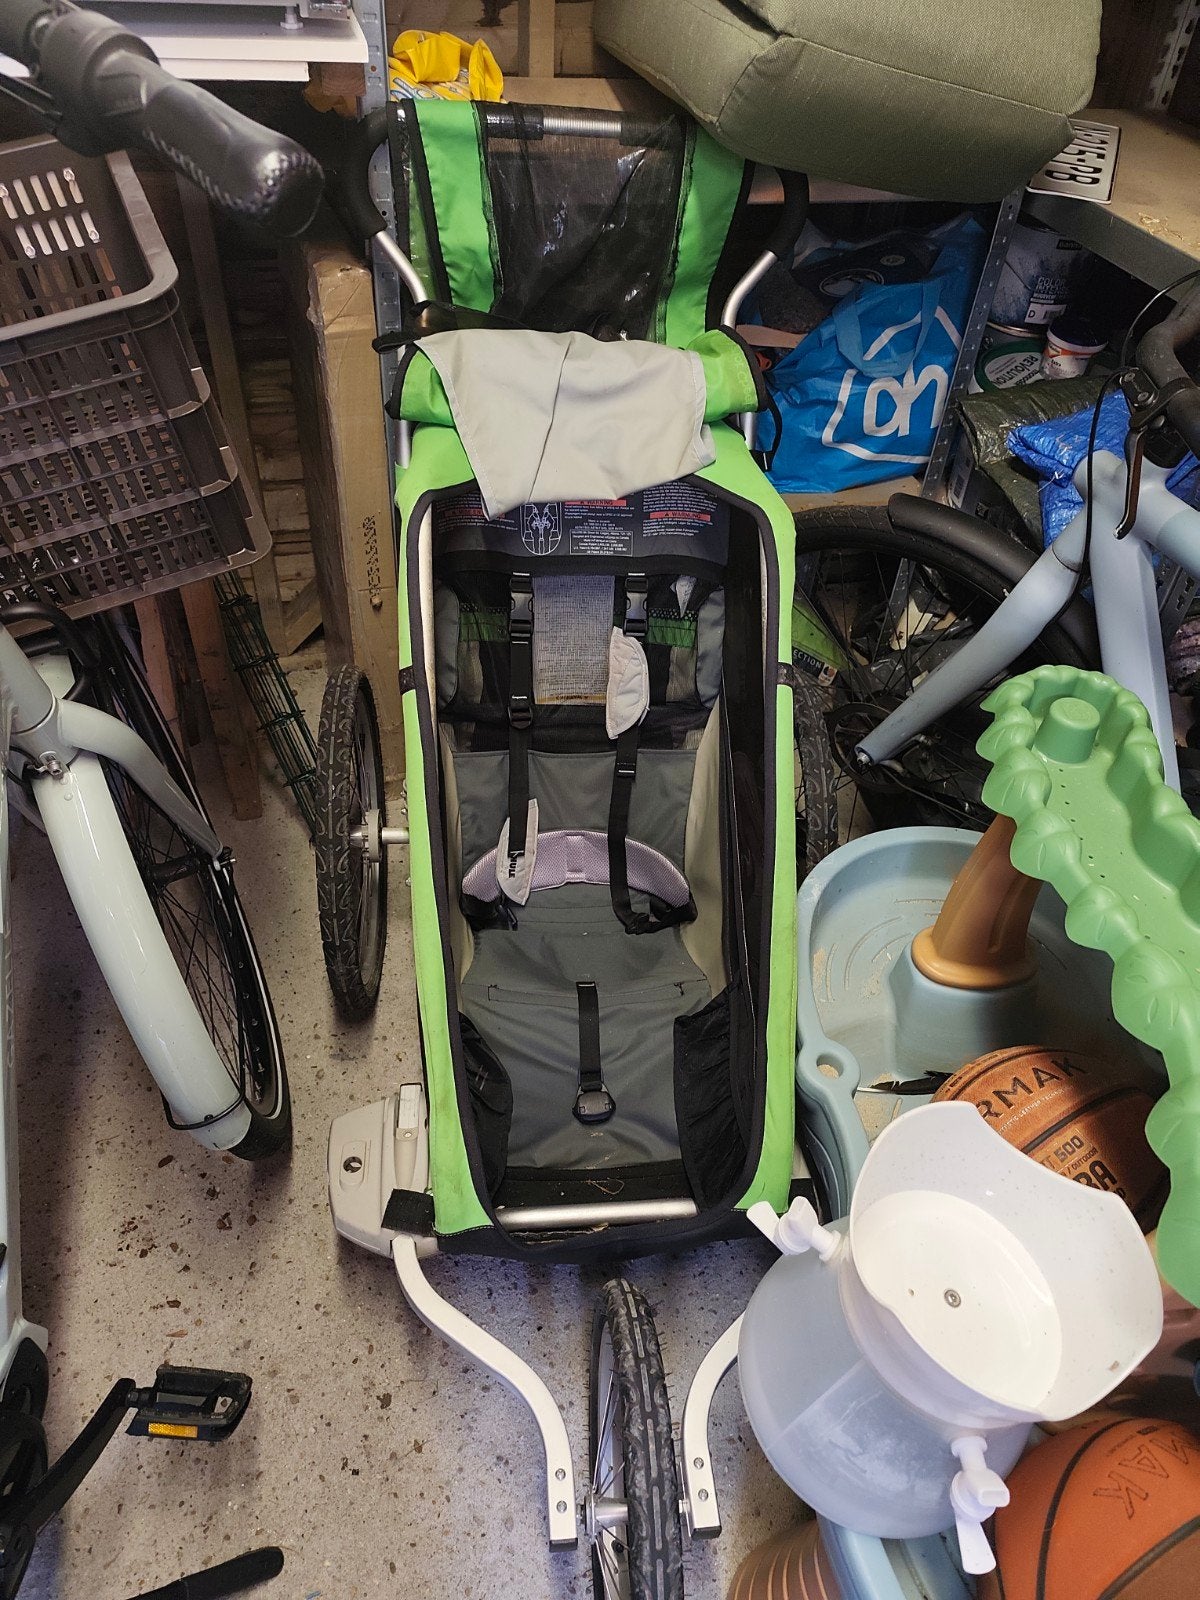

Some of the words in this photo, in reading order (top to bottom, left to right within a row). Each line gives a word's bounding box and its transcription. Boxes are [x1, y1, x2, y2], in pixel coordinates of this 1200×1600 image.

[1028, 309, 1036, 318] D
[992, 355, 1039, 385] REVOLUTION
[1054, 1135, 1085, 1163] 500
[1071, 1147, 1099, 1170] OUTDOOR
